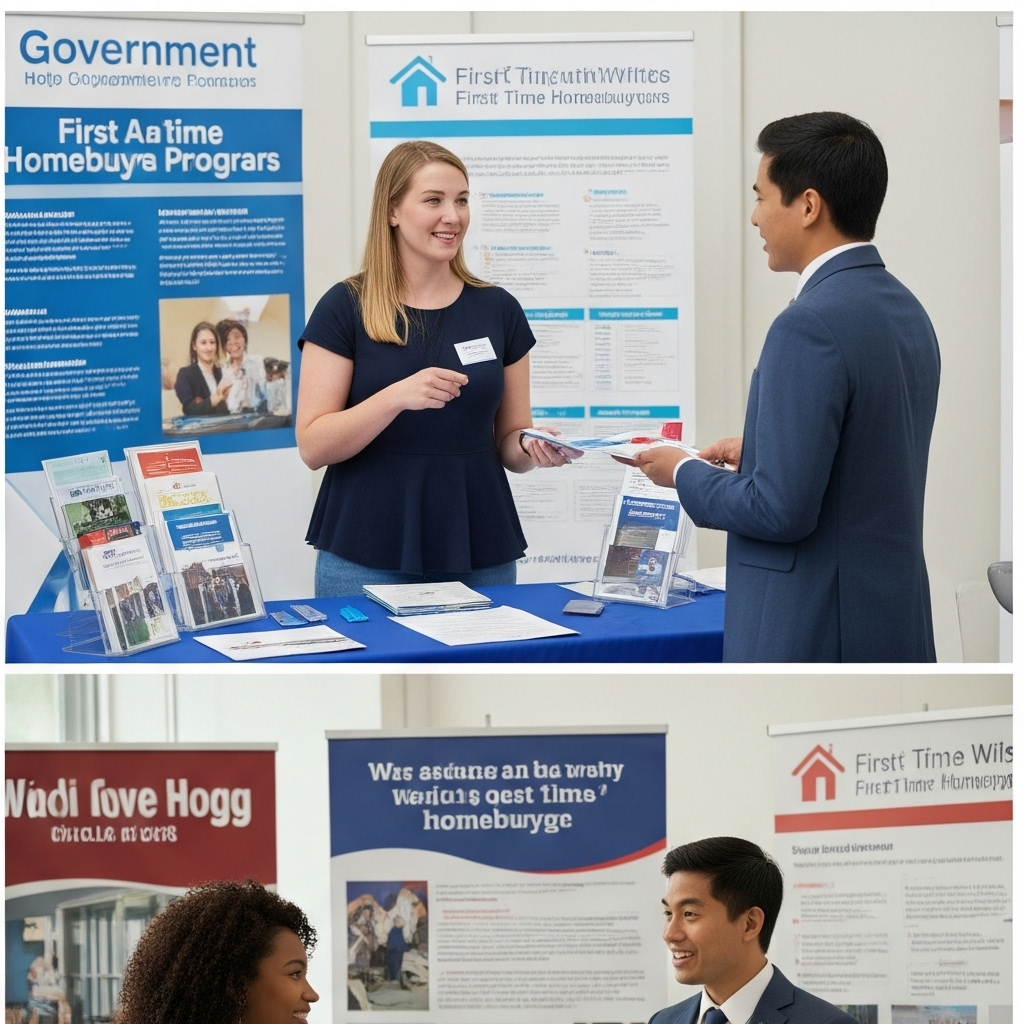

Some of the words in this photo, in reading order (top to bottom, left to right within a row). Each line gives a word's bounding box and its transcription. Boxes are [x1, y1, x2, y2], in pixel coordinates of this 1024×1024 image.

[19, 29, 258, 69] Government
[504, 89, 546, 105] Time
[58, 117, 119, 145] First
[912, 747, 965, 770] Time
[165, 778, 252, 828] Hogg
